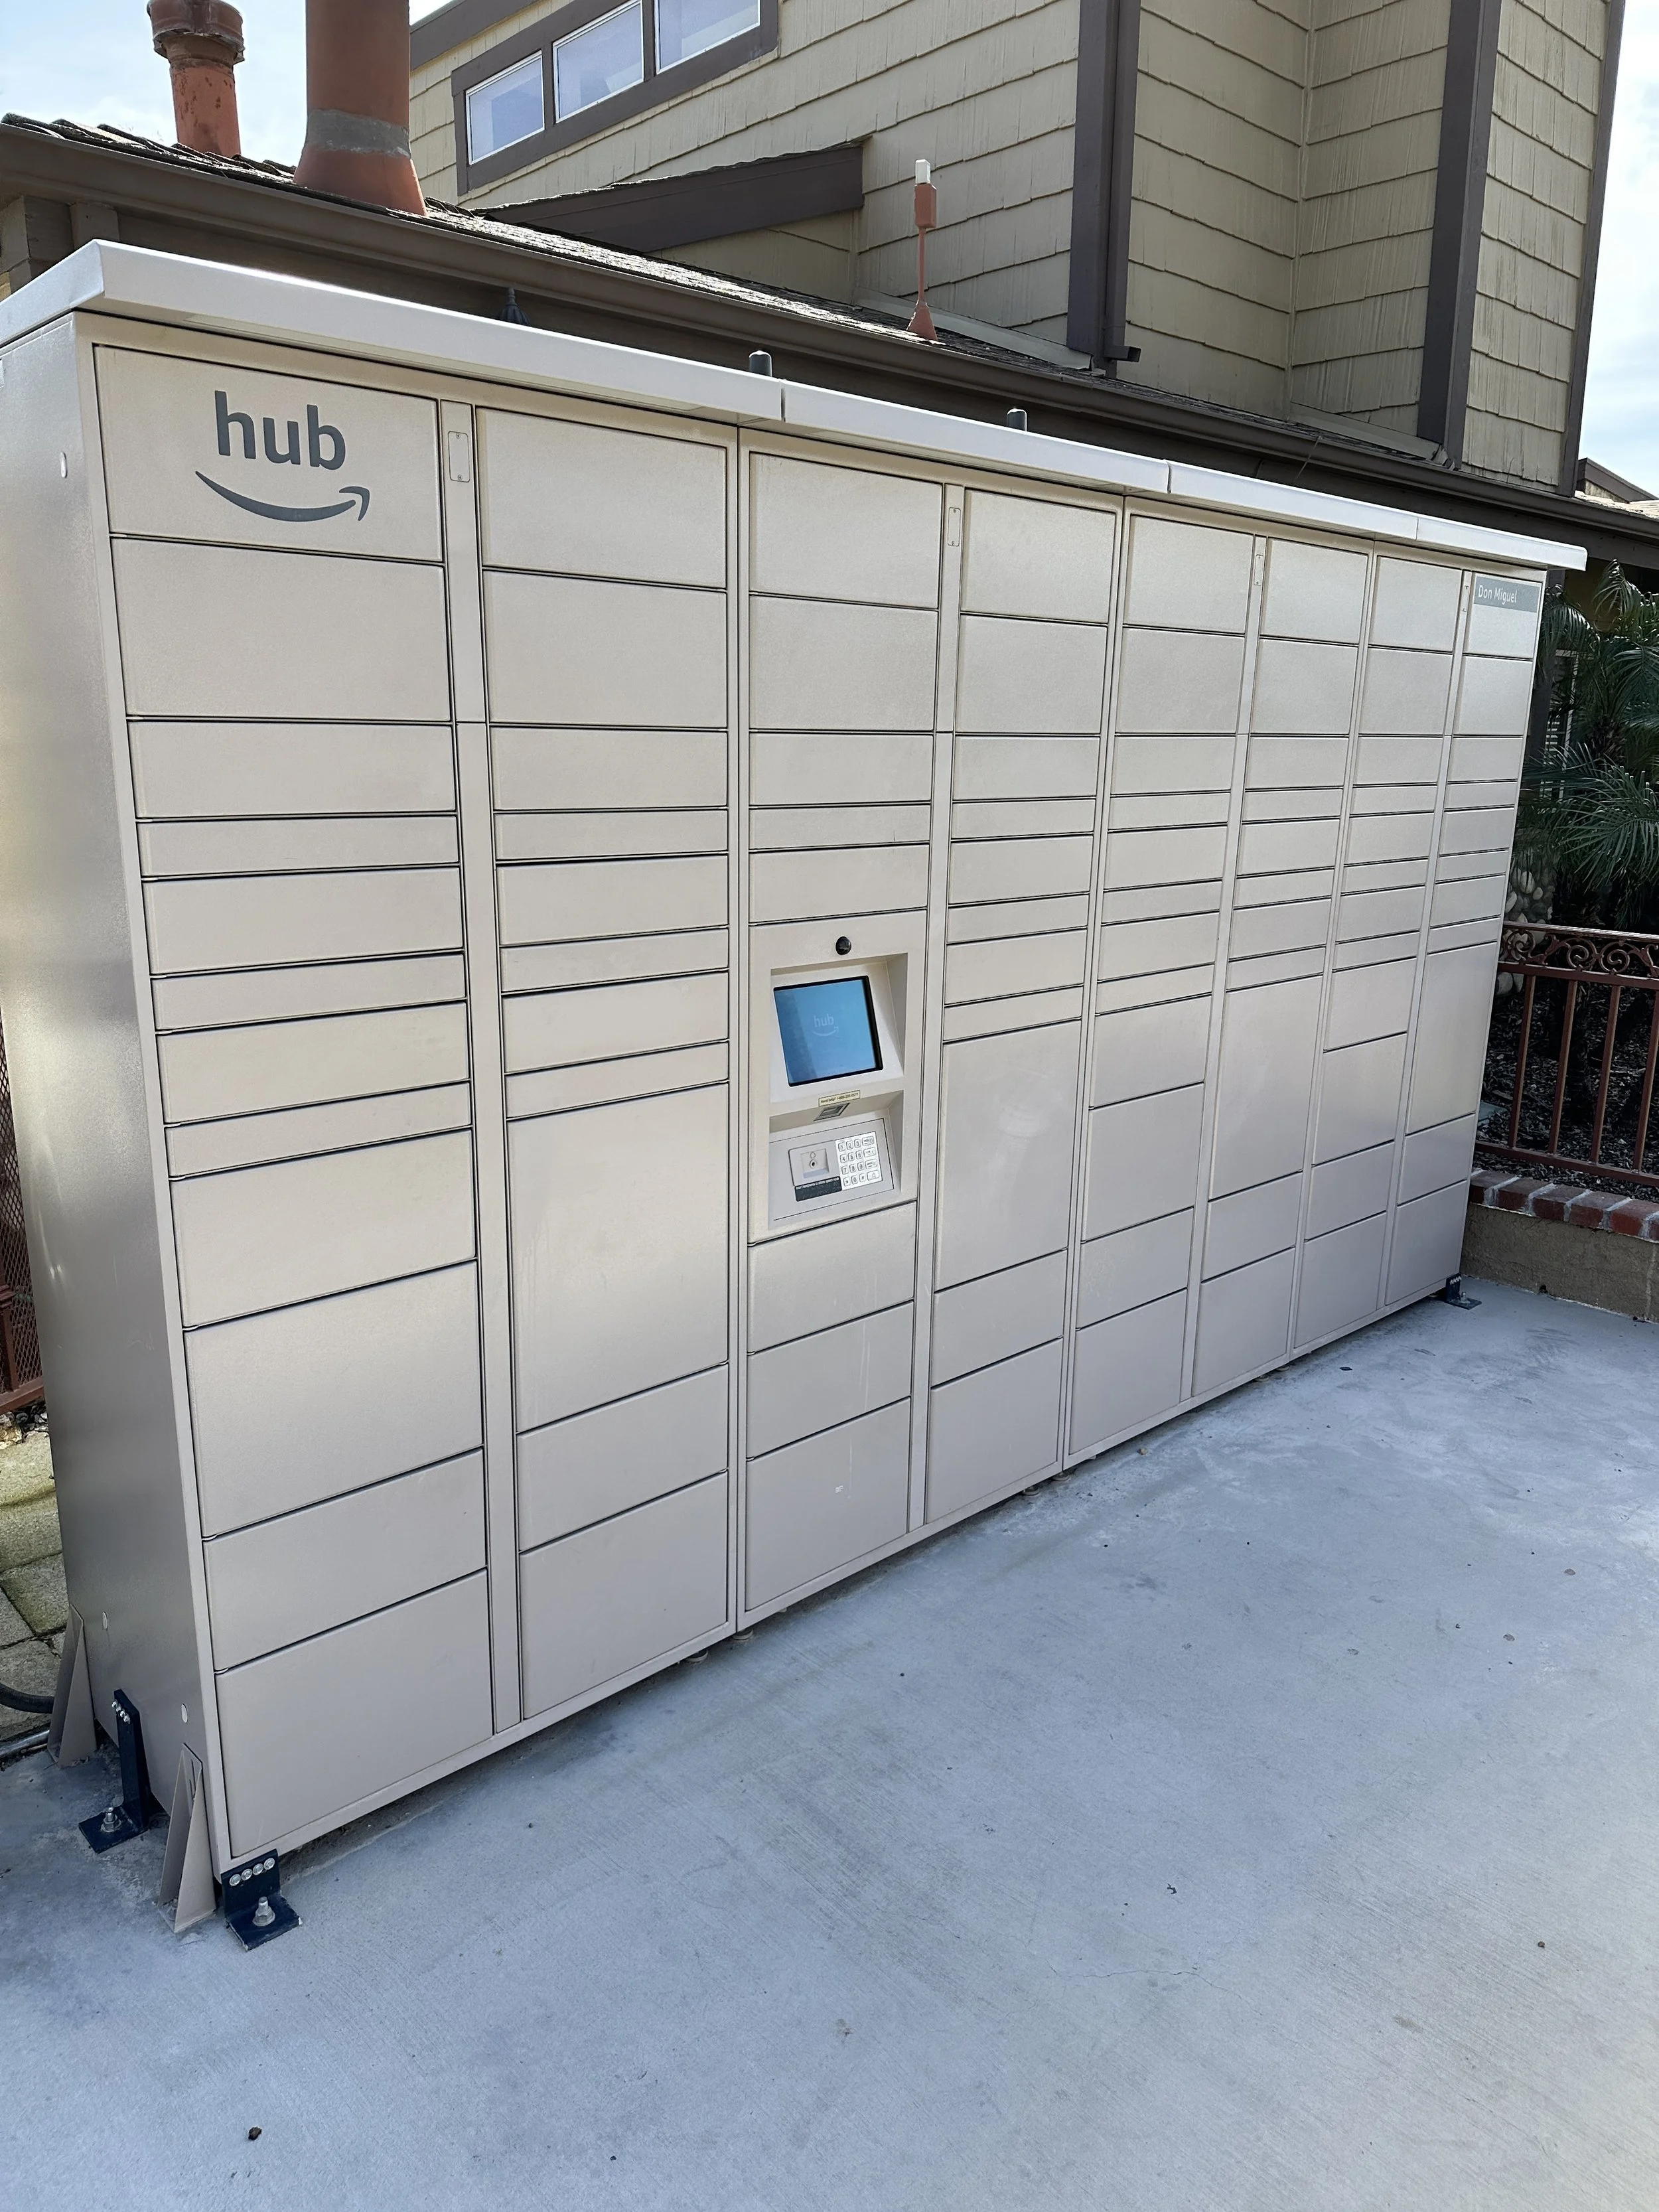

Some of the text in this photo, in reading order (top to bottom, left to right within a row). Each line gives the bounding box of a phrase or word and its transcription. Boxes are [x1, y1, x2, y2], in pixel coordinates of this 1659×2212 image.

[214, 390, 346, 471] hub
[1478, 585, 1518, 605] Don Miguel
[814, 1013, 834, 1027] hub
